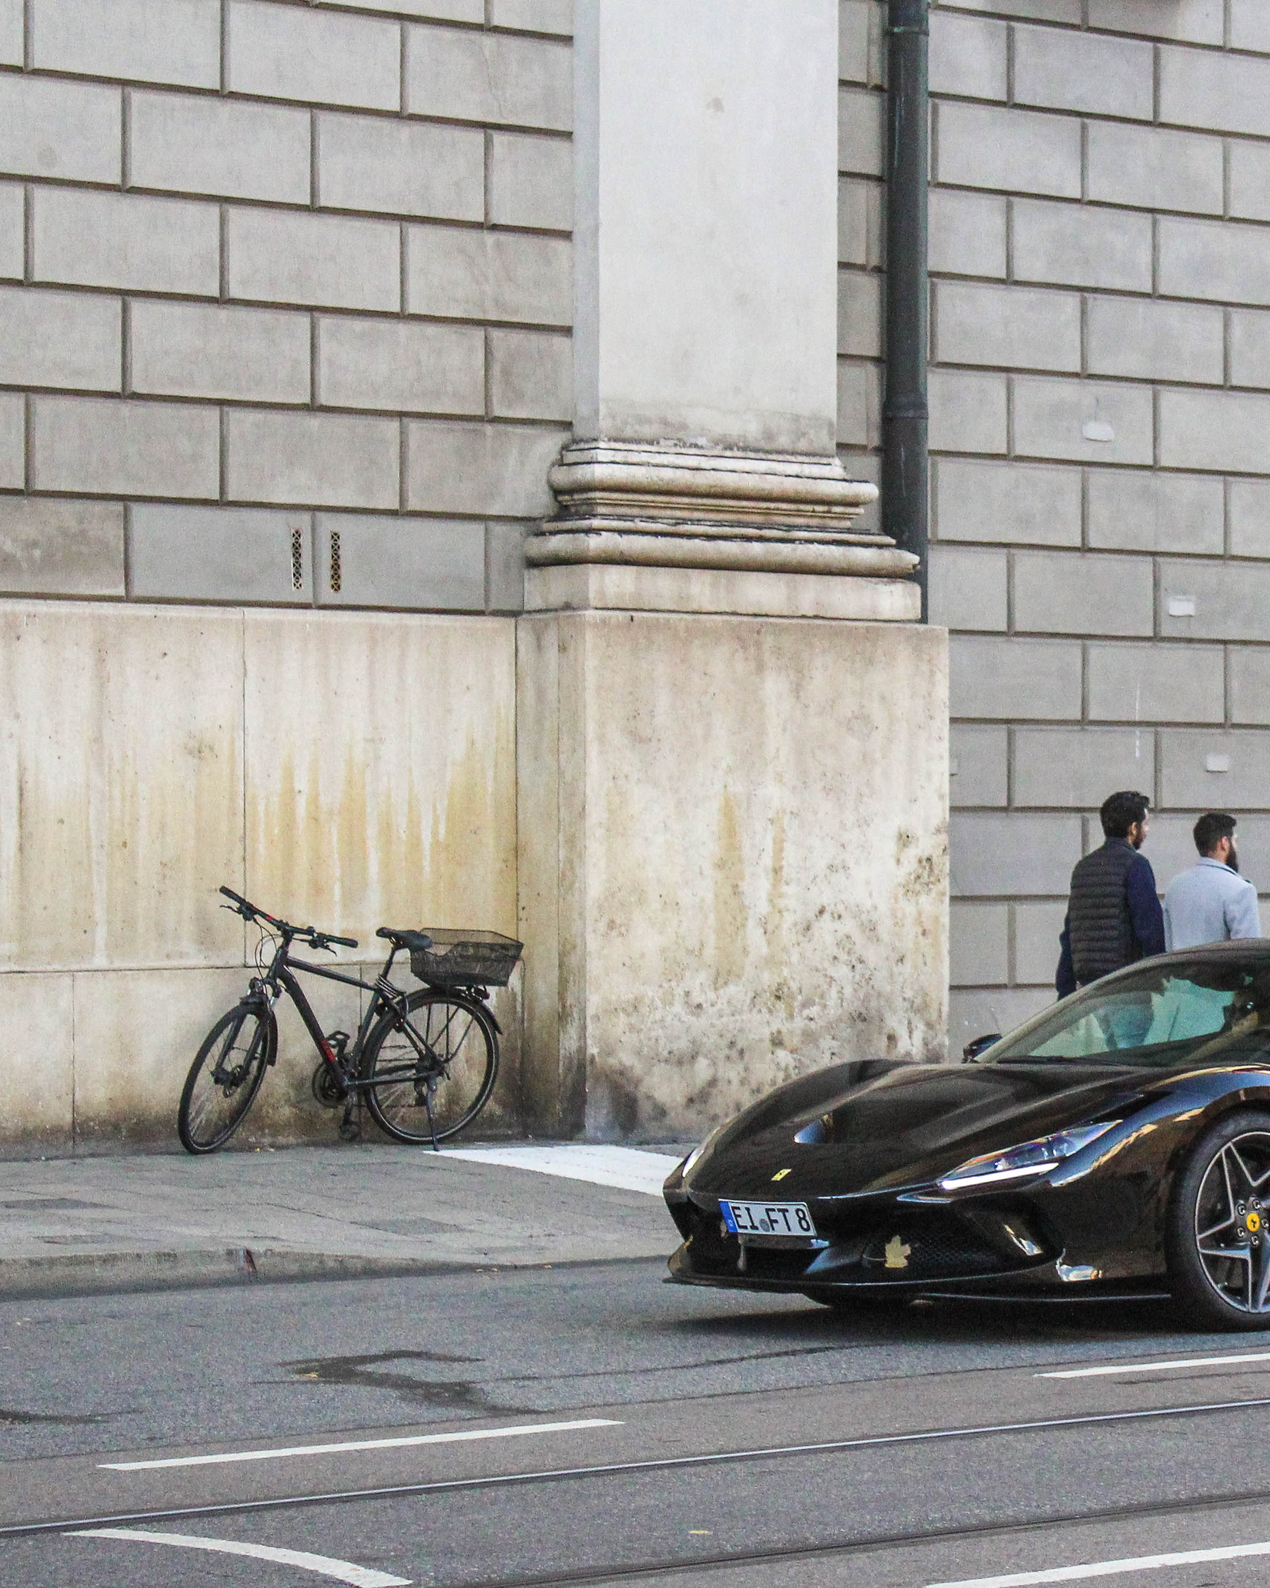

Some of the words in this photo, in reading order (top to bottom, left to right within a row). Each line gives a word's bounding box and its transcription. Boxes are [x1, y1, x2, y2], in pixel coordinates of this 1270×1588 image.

[731, 1205, 759, 1231] EI
[765, 1207, 792, 1233] FT
[795, 1207, 811, 1232] 8
